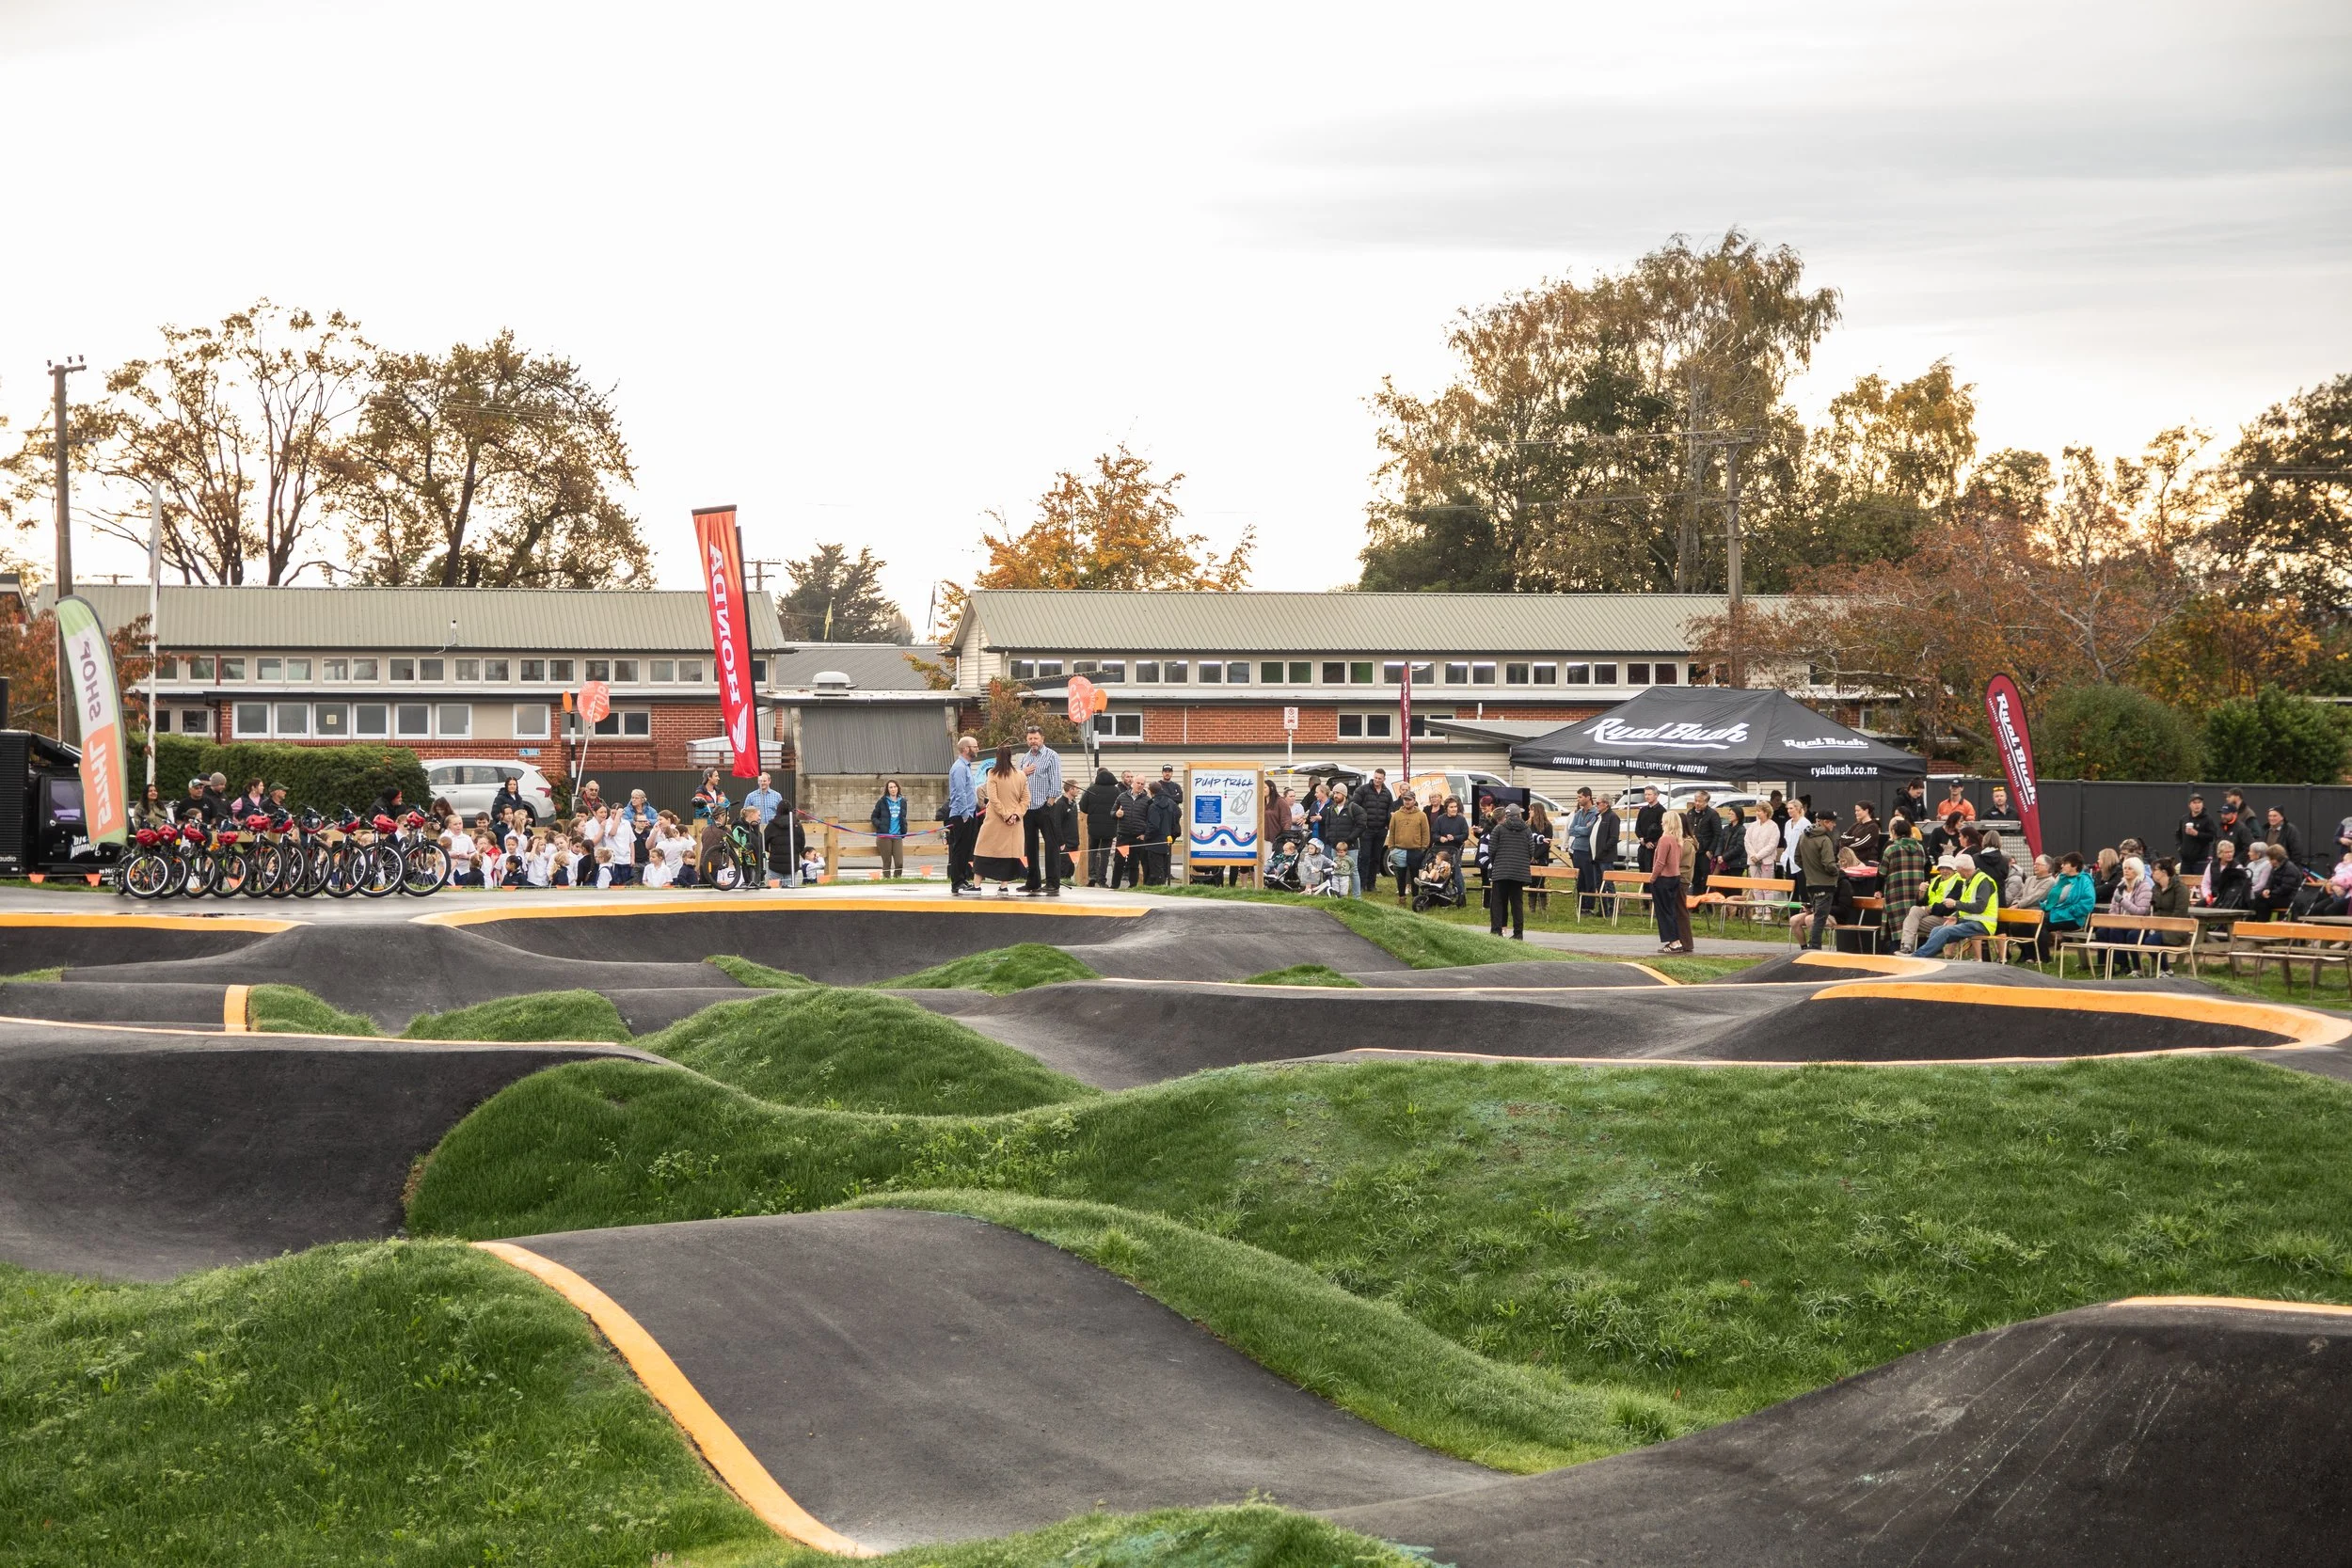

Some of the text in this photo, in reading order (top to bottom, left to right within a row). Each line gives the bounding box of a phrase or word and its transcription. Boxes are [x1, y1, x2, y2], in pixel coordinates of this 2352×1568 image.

[587, 685, 609, 721] STOP
[1070, 684, 1087, 720] STOP
[1583, 718, 1750, 745] Ryal Bush
[1782, 737, 1868, 749] Ryal Bush
[1995, 693, 2037, 805] Ryal Bush
[1552, 756, 1584, 766] EXCAVATION
[1589, 758, 1620, 768] DEMOLITION
[1677, 764, 1708, 774] TRANSPORT
[1810, 764, 1878, 778] ryalbush.co.nz
[1194, 777, 1254, 787] PUMP TRACK
